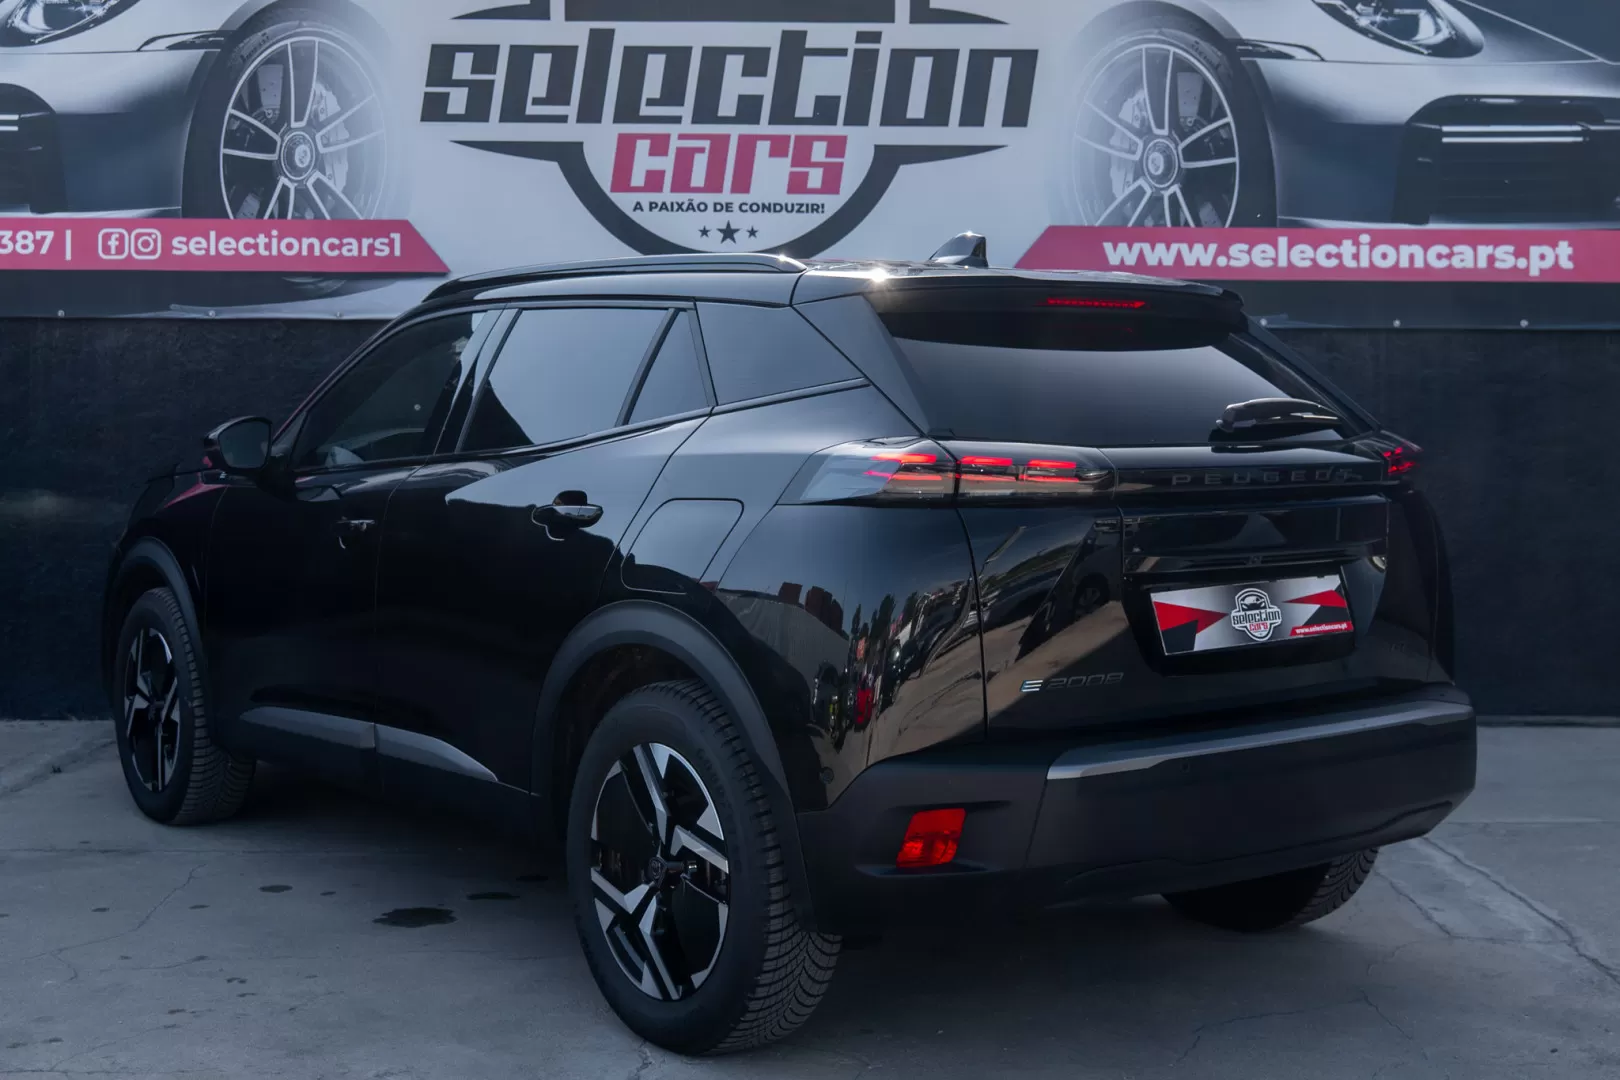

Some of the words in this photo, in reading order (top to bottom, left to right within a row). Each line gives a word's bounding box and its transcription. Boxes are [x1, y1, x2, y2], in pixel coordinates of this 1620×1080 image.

[419, 28, 1039, 128] selection
[610, 133, 848, 195] cars
[632, 200, 644, 212] A
[649, 198, 708, 213] PAIXÃO
[713, 202, 734, 213] DE
[738, 202, 825, 214] CONDUZIR!
[0, 229, 55, 255] 387
[171, 231, 401, 258] selectioncars1
[1102, 233, 1574, 277] www.selectioncars.pt
[1171, 468, 1354, 486] PEUGEOT
[1232, 610, 1281, 625] selection
[1249, 622, 1269, 631] cars
[1046, 672, 1124, 690] 2008
